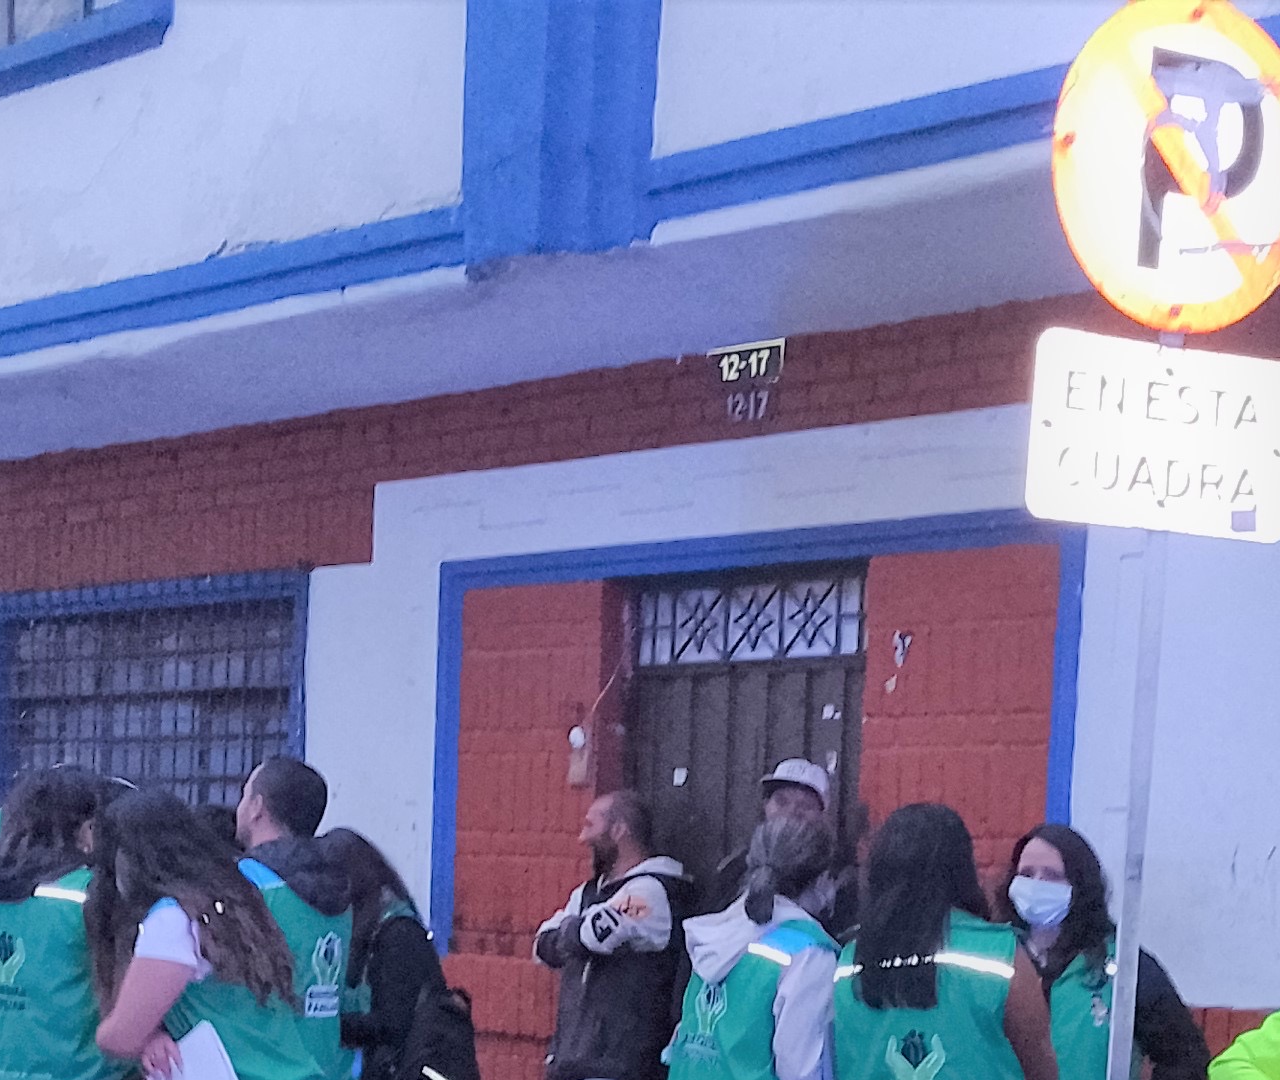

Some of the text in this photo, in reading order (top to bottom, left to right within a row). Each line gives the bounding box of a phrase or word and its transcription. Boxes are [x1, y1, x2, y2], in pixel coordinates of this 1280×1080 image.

[718, 348, 771, 382] 12-17
[1066, 370, 1258, 430] EN ESTA
